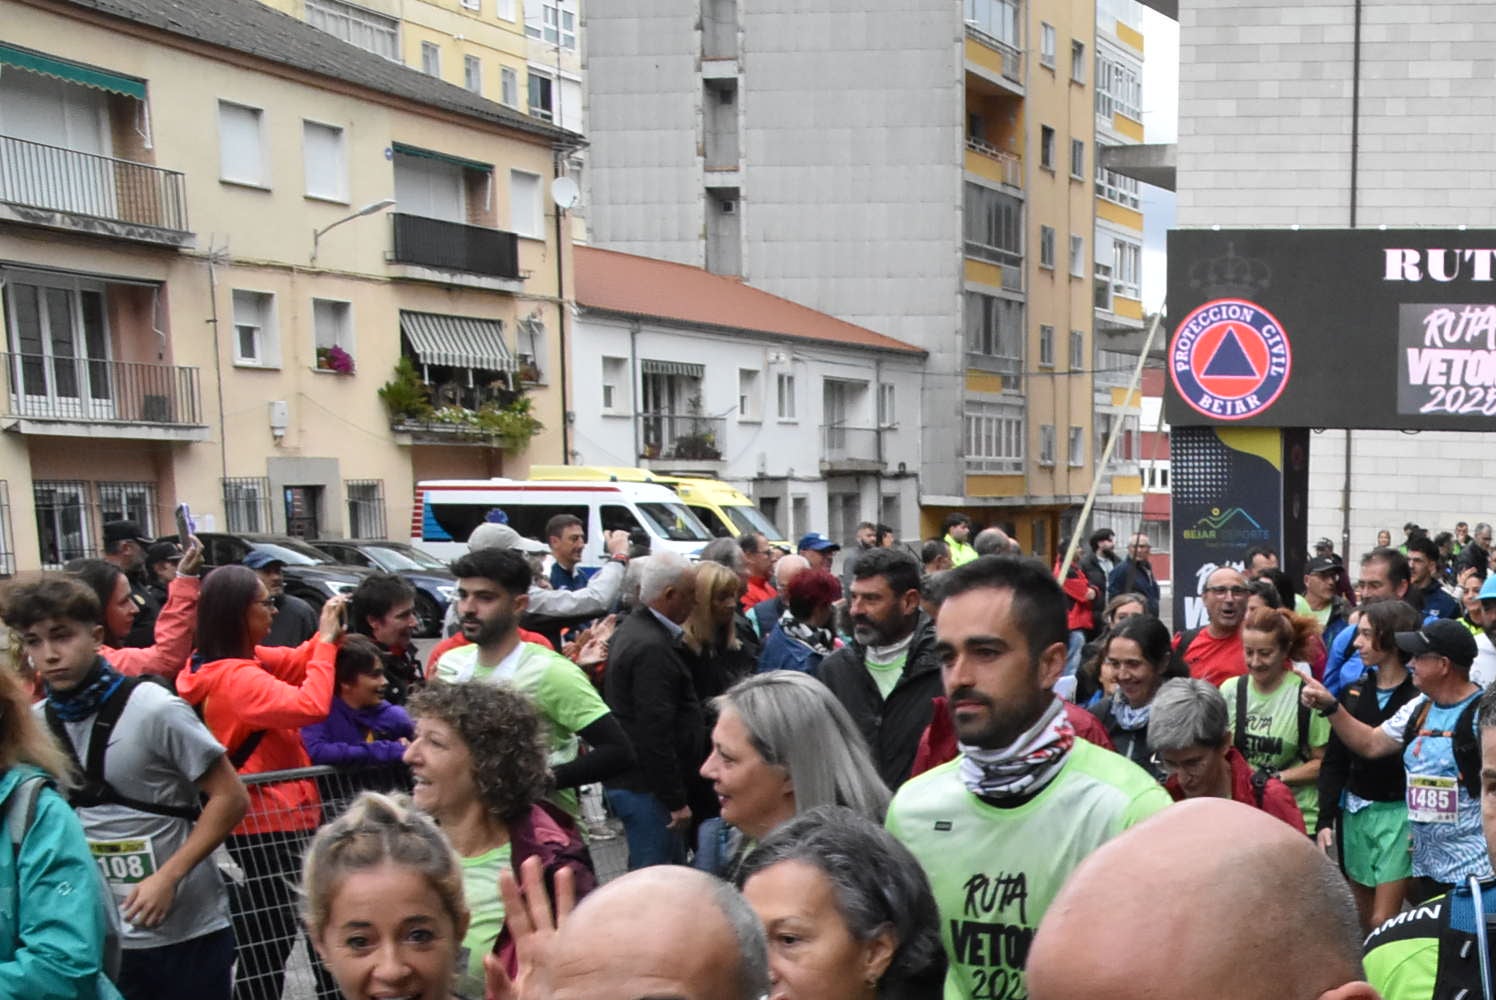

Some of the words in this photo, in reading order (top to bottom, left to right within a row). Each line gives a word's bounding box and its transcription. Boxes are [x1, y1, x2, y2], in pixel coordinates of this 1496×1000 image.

[1175, 304, 1255, 372] PROTECCION
[1261, 324, 1287, 377] CIVIL
[1198, 394, 1261, 415] BEJAR
[1410, 788, 1450, 809] 1485
[963, 871, 1028, 925] RUTA
